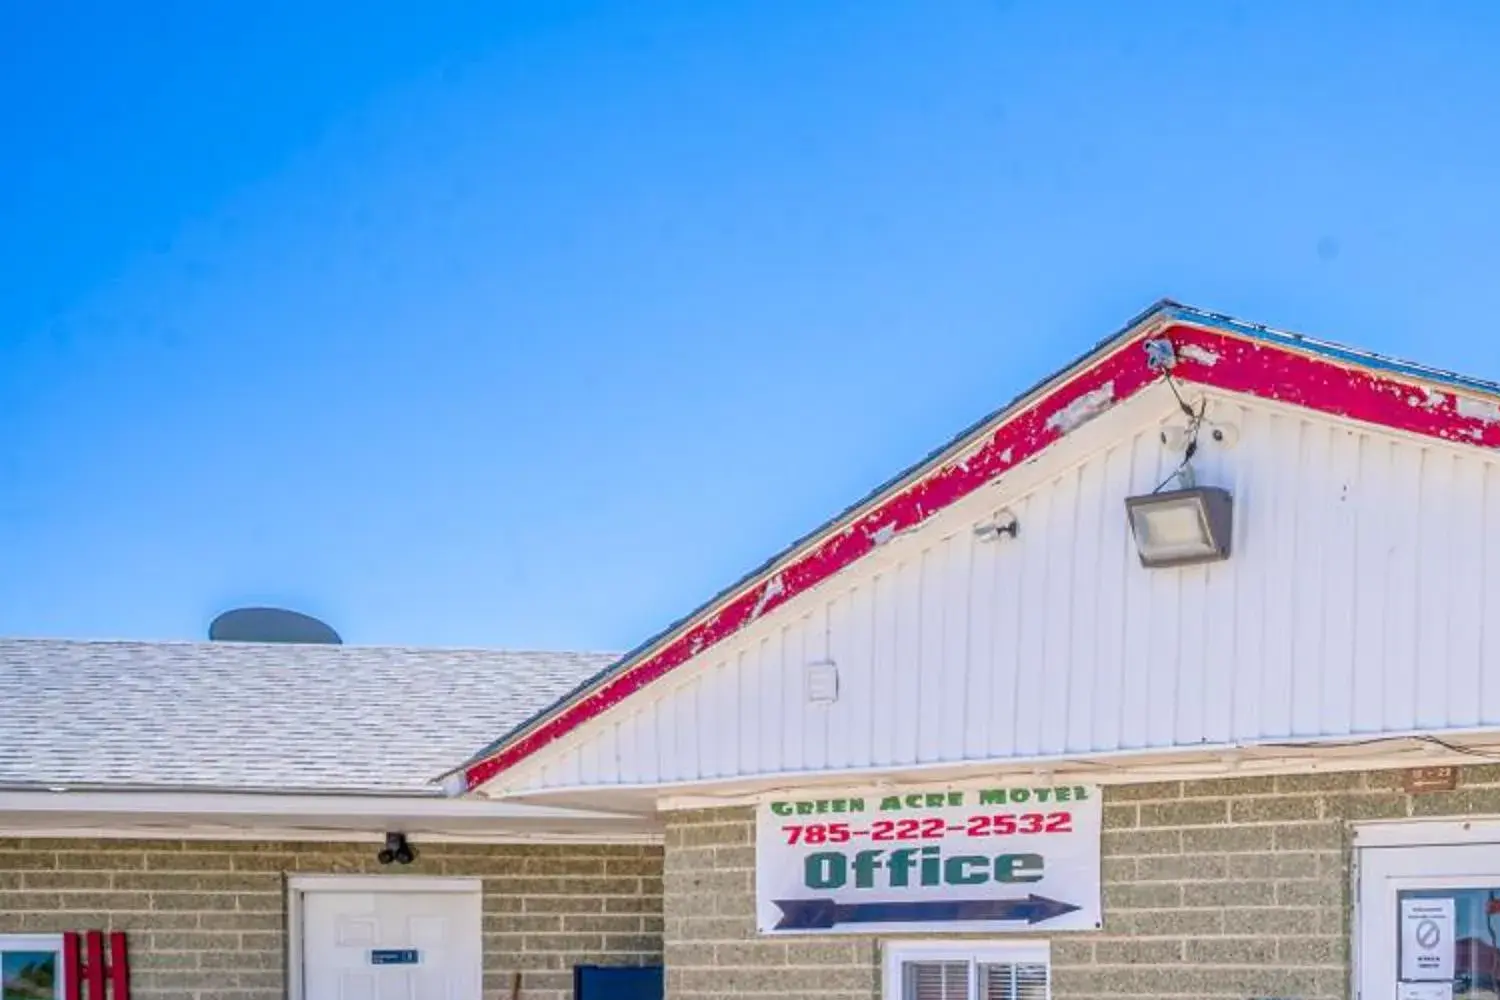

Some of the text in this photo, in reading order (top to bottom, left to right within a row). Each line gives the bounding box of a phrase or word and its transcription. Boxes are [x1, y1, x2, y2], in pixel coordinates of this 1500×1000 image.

[770, 785, 1089, 817] GREEN ACRE MOTEL
[781, 811, 1073, 846] 785-222-2532
[804, 845, 1045, 890] Office
